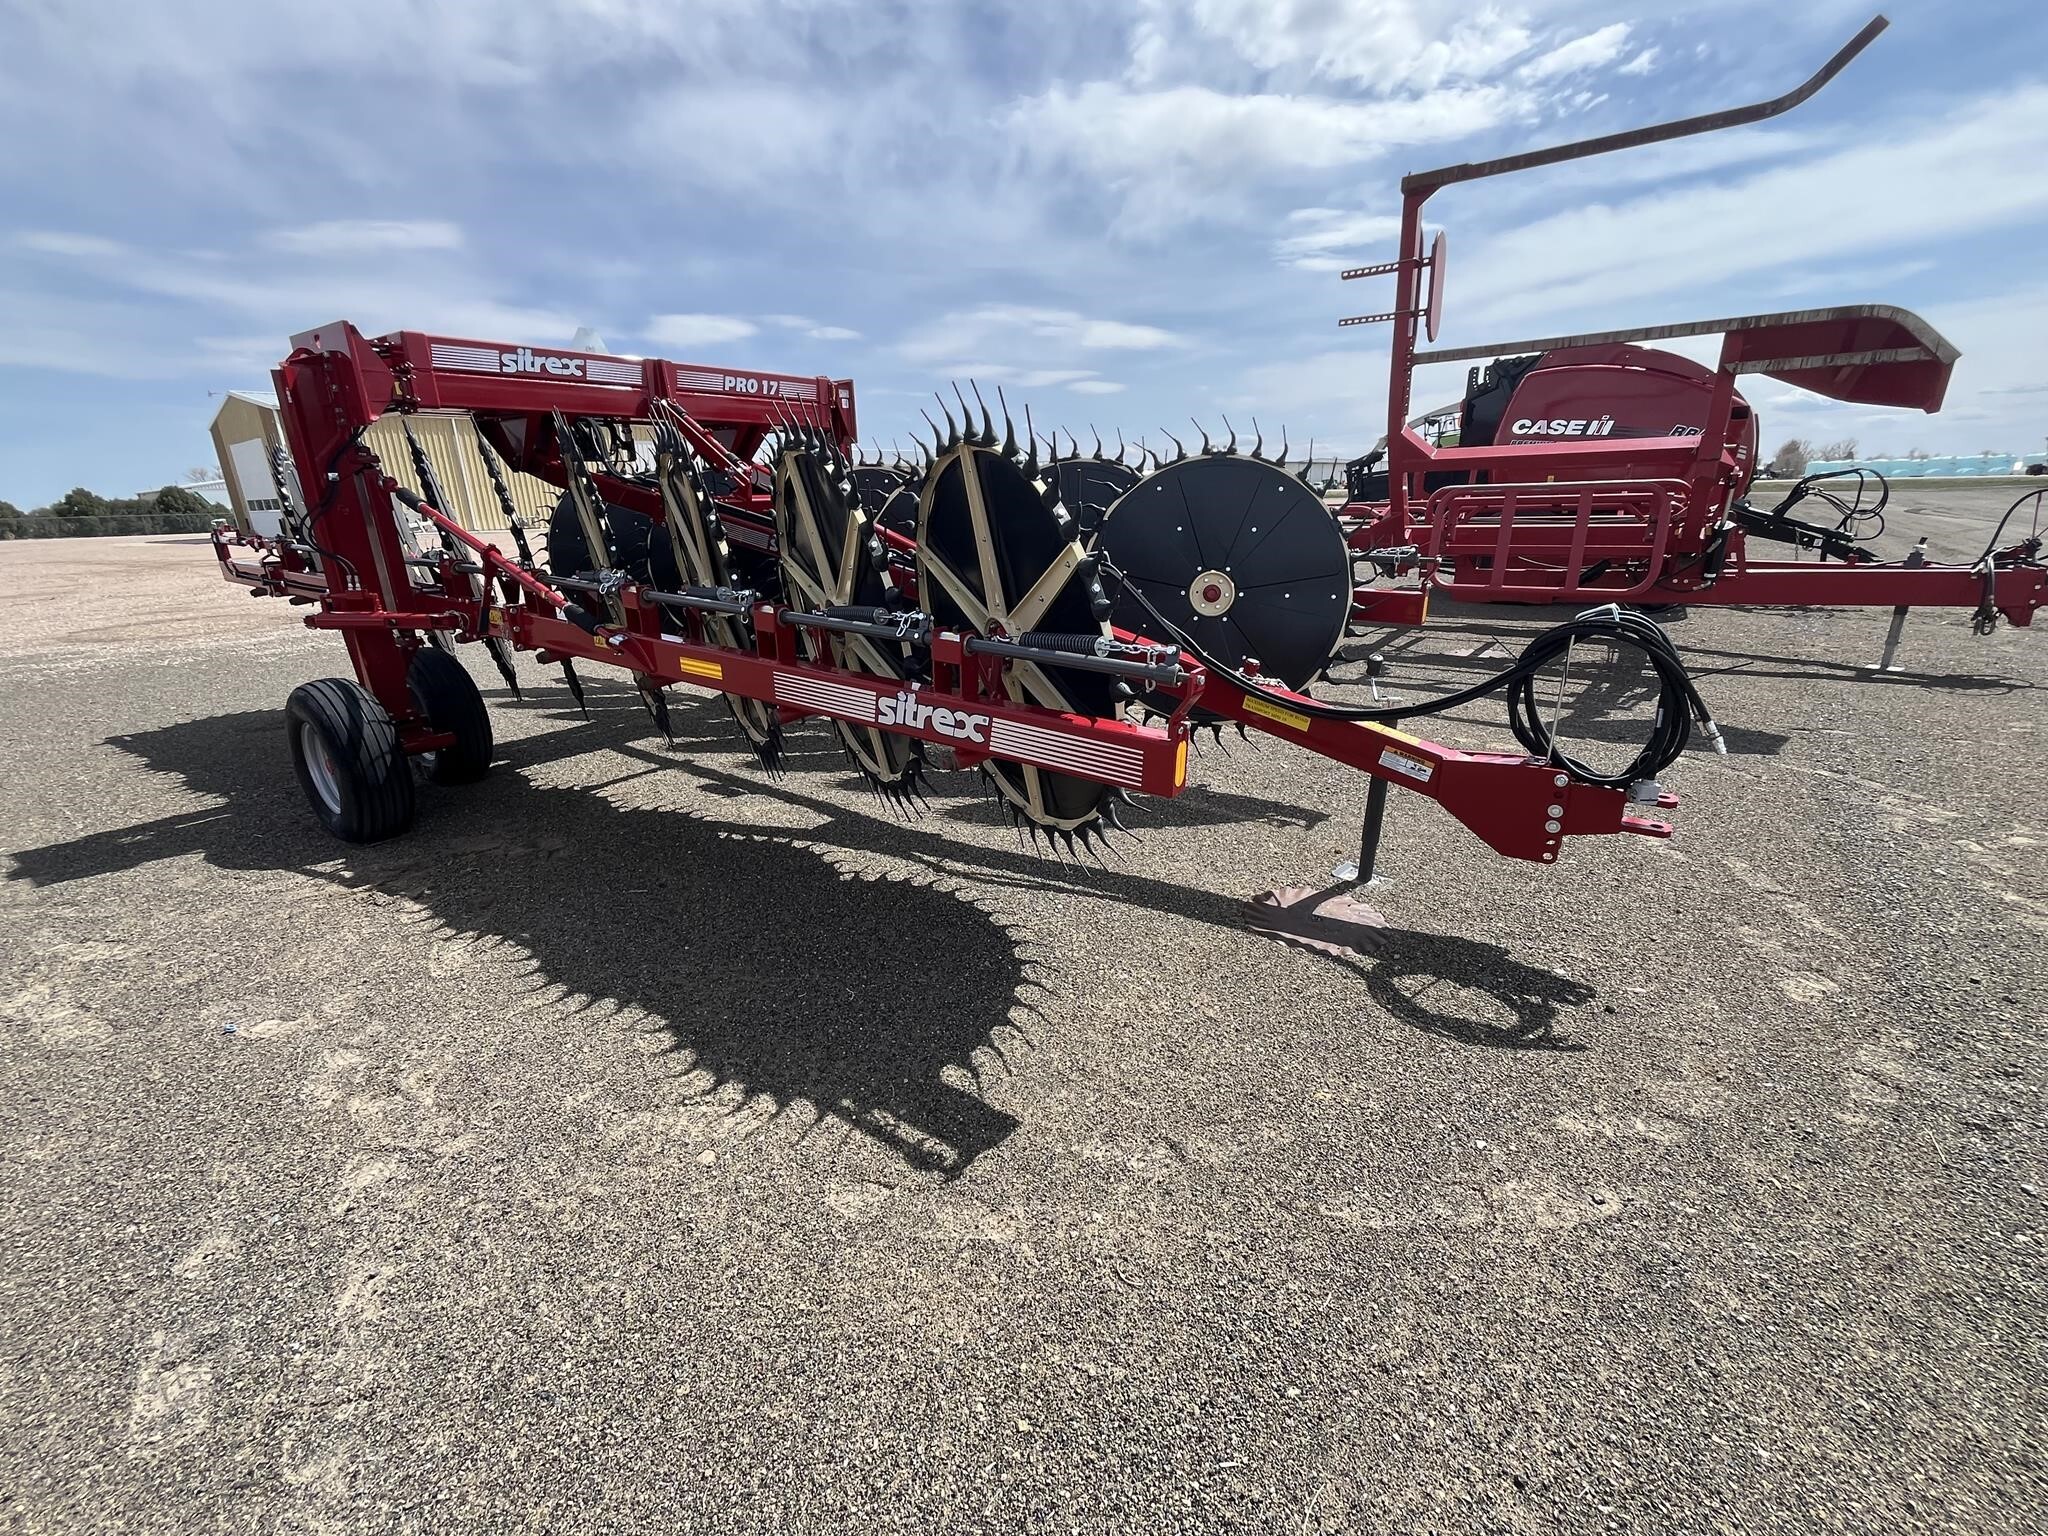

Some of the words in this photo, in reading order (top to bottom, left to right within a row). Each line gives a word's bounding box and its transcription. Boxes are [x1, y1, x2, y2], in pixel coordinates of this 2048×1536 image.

[501, 347, 585, 377] sitrex
[724, 375, 758, 394] PRO
[761, 380, 779, 396] 17
[1511, 419, 1587, 435] CASE
[878, 690, 990, 743] sitrex
